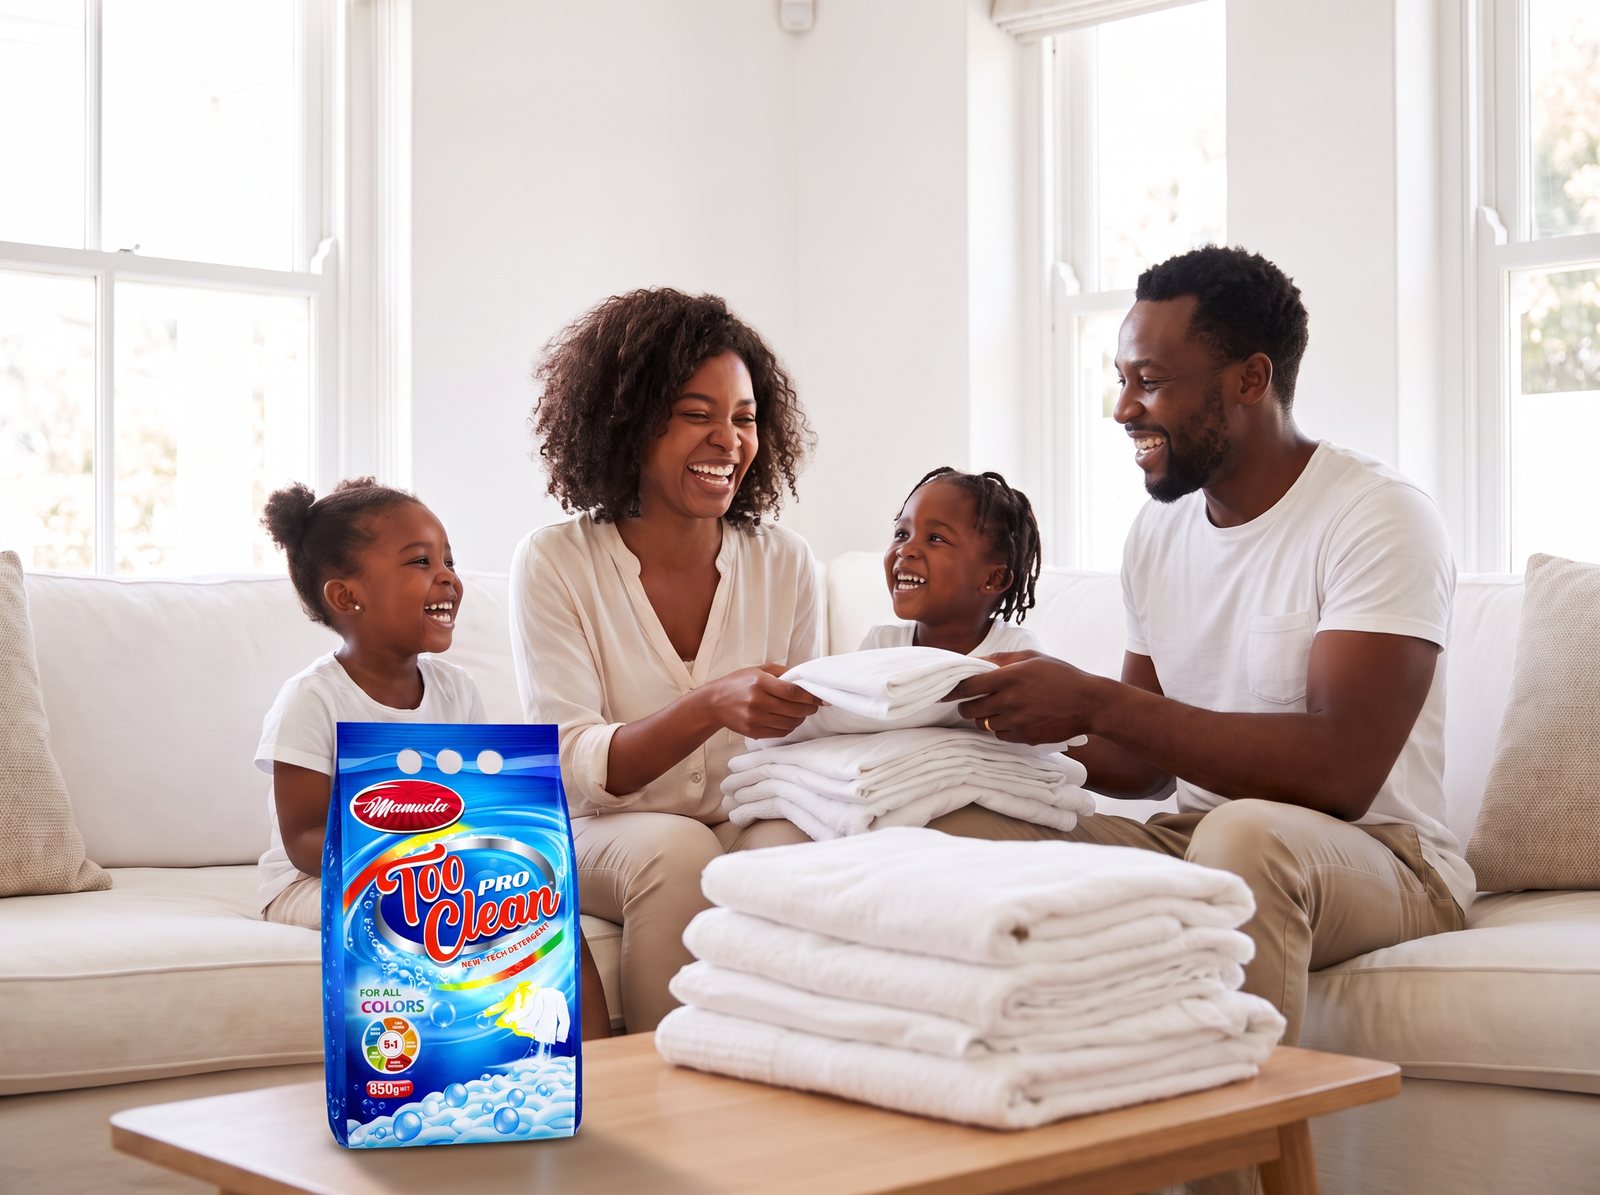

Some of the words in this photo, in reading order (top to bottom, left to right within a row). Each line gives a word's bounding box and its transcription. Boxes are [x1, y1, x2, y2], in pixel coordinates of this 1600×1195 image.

[362, 796, 450, 819] Mamuda
[376, 843, 465, 926] Too
[478, 871, 530, 896] PRO
[424, 886, 561, 963] Clean
[507, 922, 549, 954] DETERGENT
[360, 989, 380, 997] FOR
[382, 988, 402, 997] ALL
[361, 1000, 425, 1014] COLORS
[369, 1082, 400, 1096] 850g
